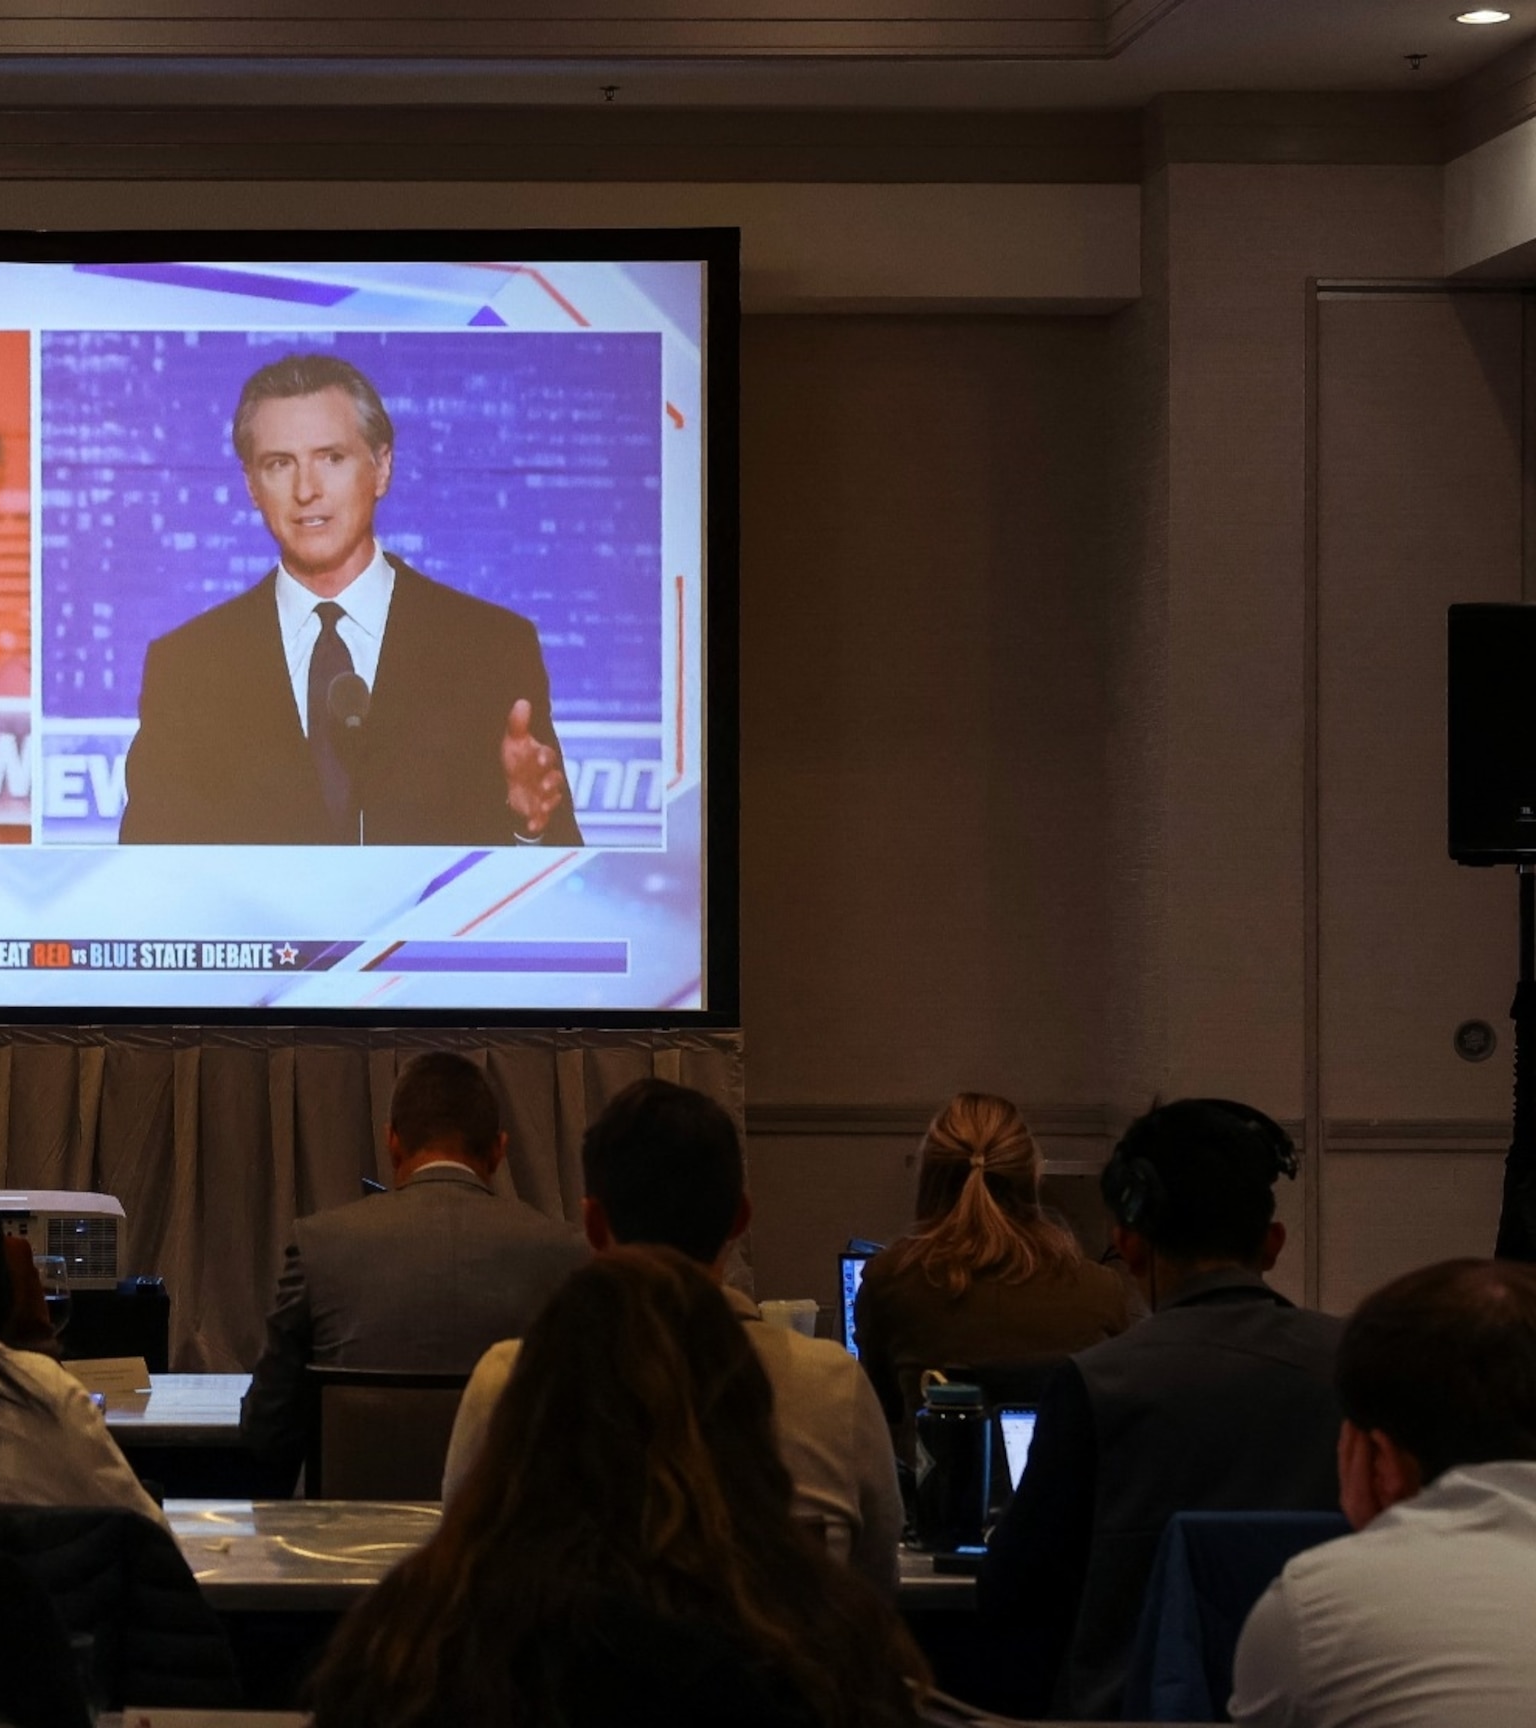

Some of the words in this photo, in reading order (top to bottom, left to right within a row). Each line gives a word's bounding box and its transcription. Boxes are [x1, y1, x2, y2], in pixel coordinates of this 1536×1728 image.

[33, 943, 70, 967] RED
[90, 942, 137, 968] BLUE
[140, 942, 197, 968] STATE
[202, 942, 273, 968] DEBATE
